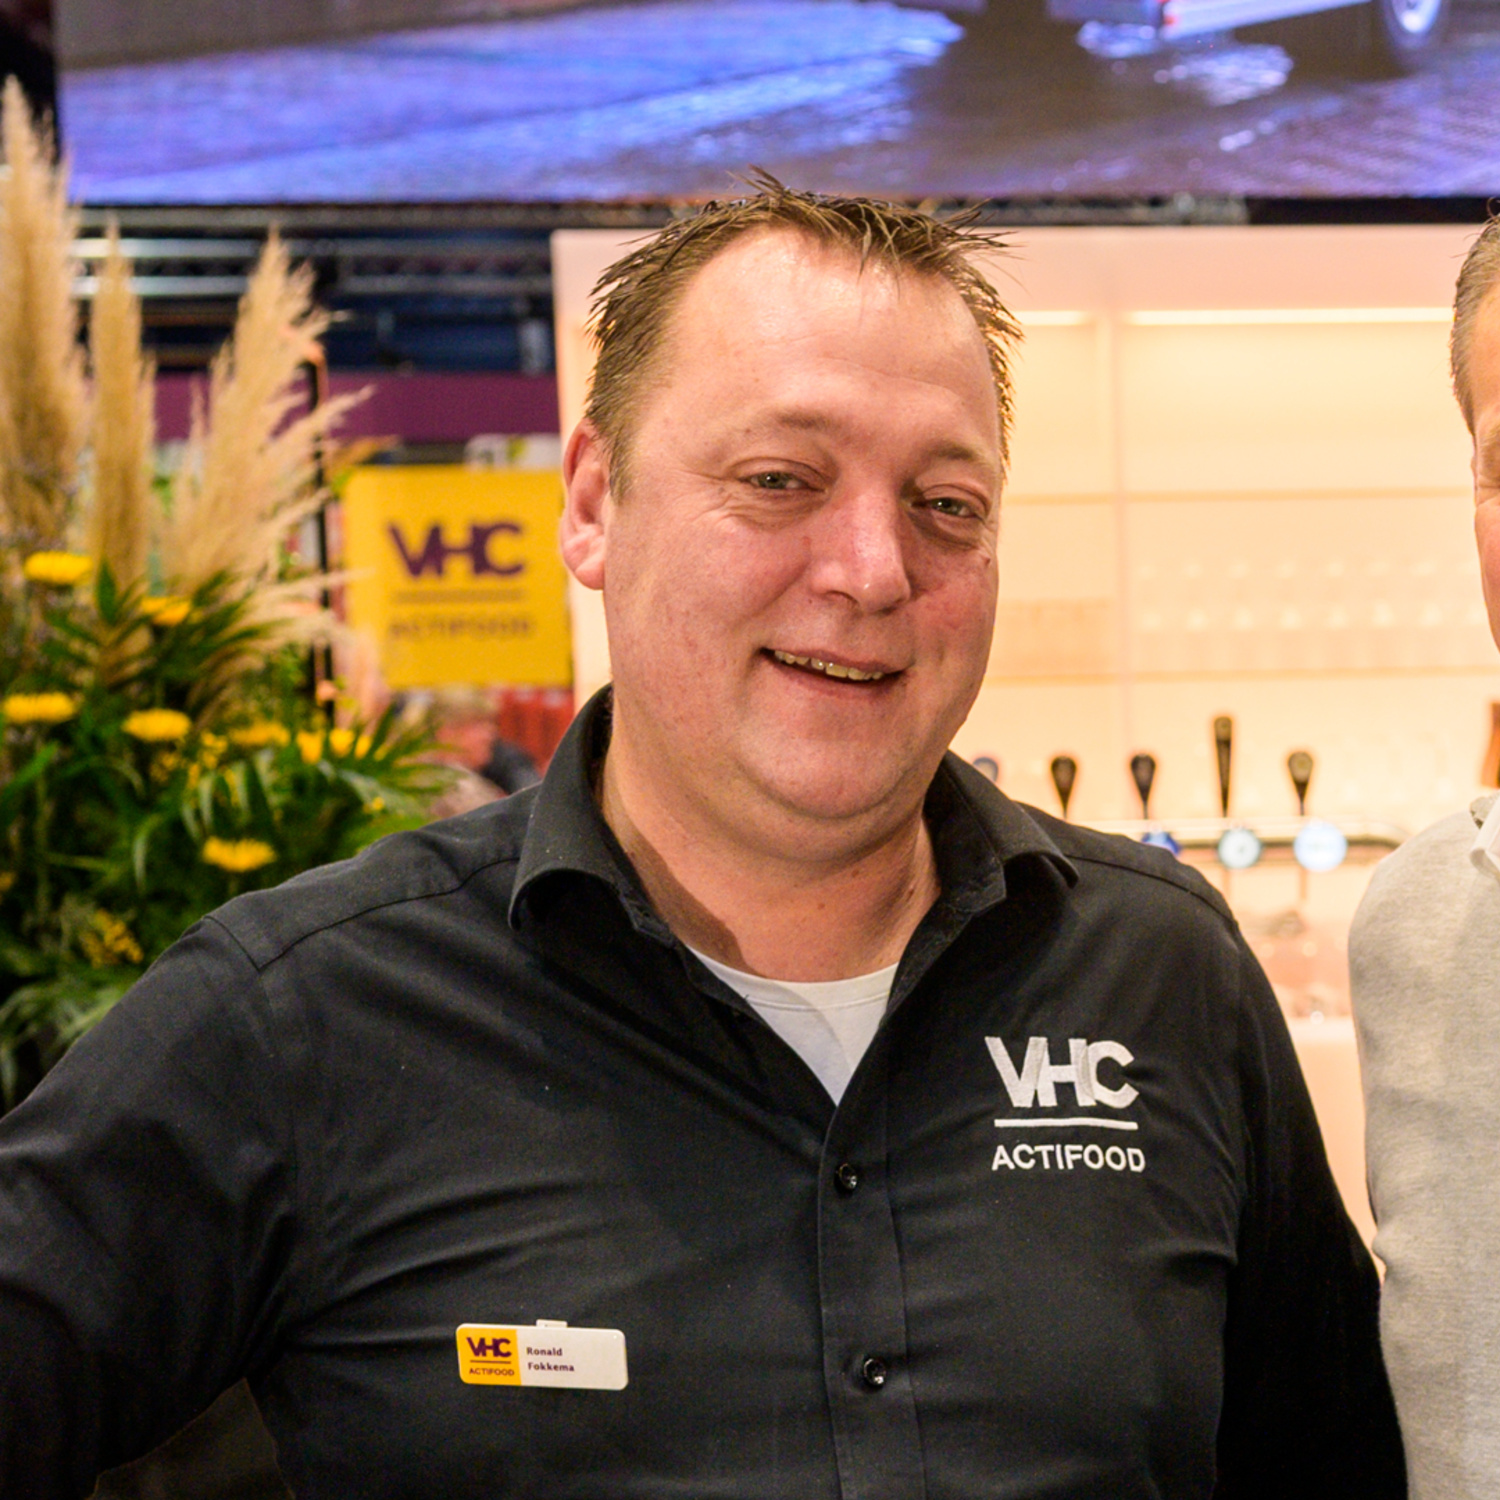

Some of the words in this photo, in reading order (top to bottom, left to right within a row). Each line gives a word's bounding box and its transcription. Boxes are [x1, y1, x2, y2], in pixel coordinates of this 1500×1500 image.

[388, 520, 524, 577] VHC
[984, 1036, 1140, 1109] VHC
[991, 1144, 1146, 1173] ACTIFOOD
[466, 1336, 512, 1358] VHC
[526, 1347, 563, 1357] Ronald
[469, 1367, 515, 1377] ACTIFOOD
[528, 1362, 575, 1372] Fokkema
